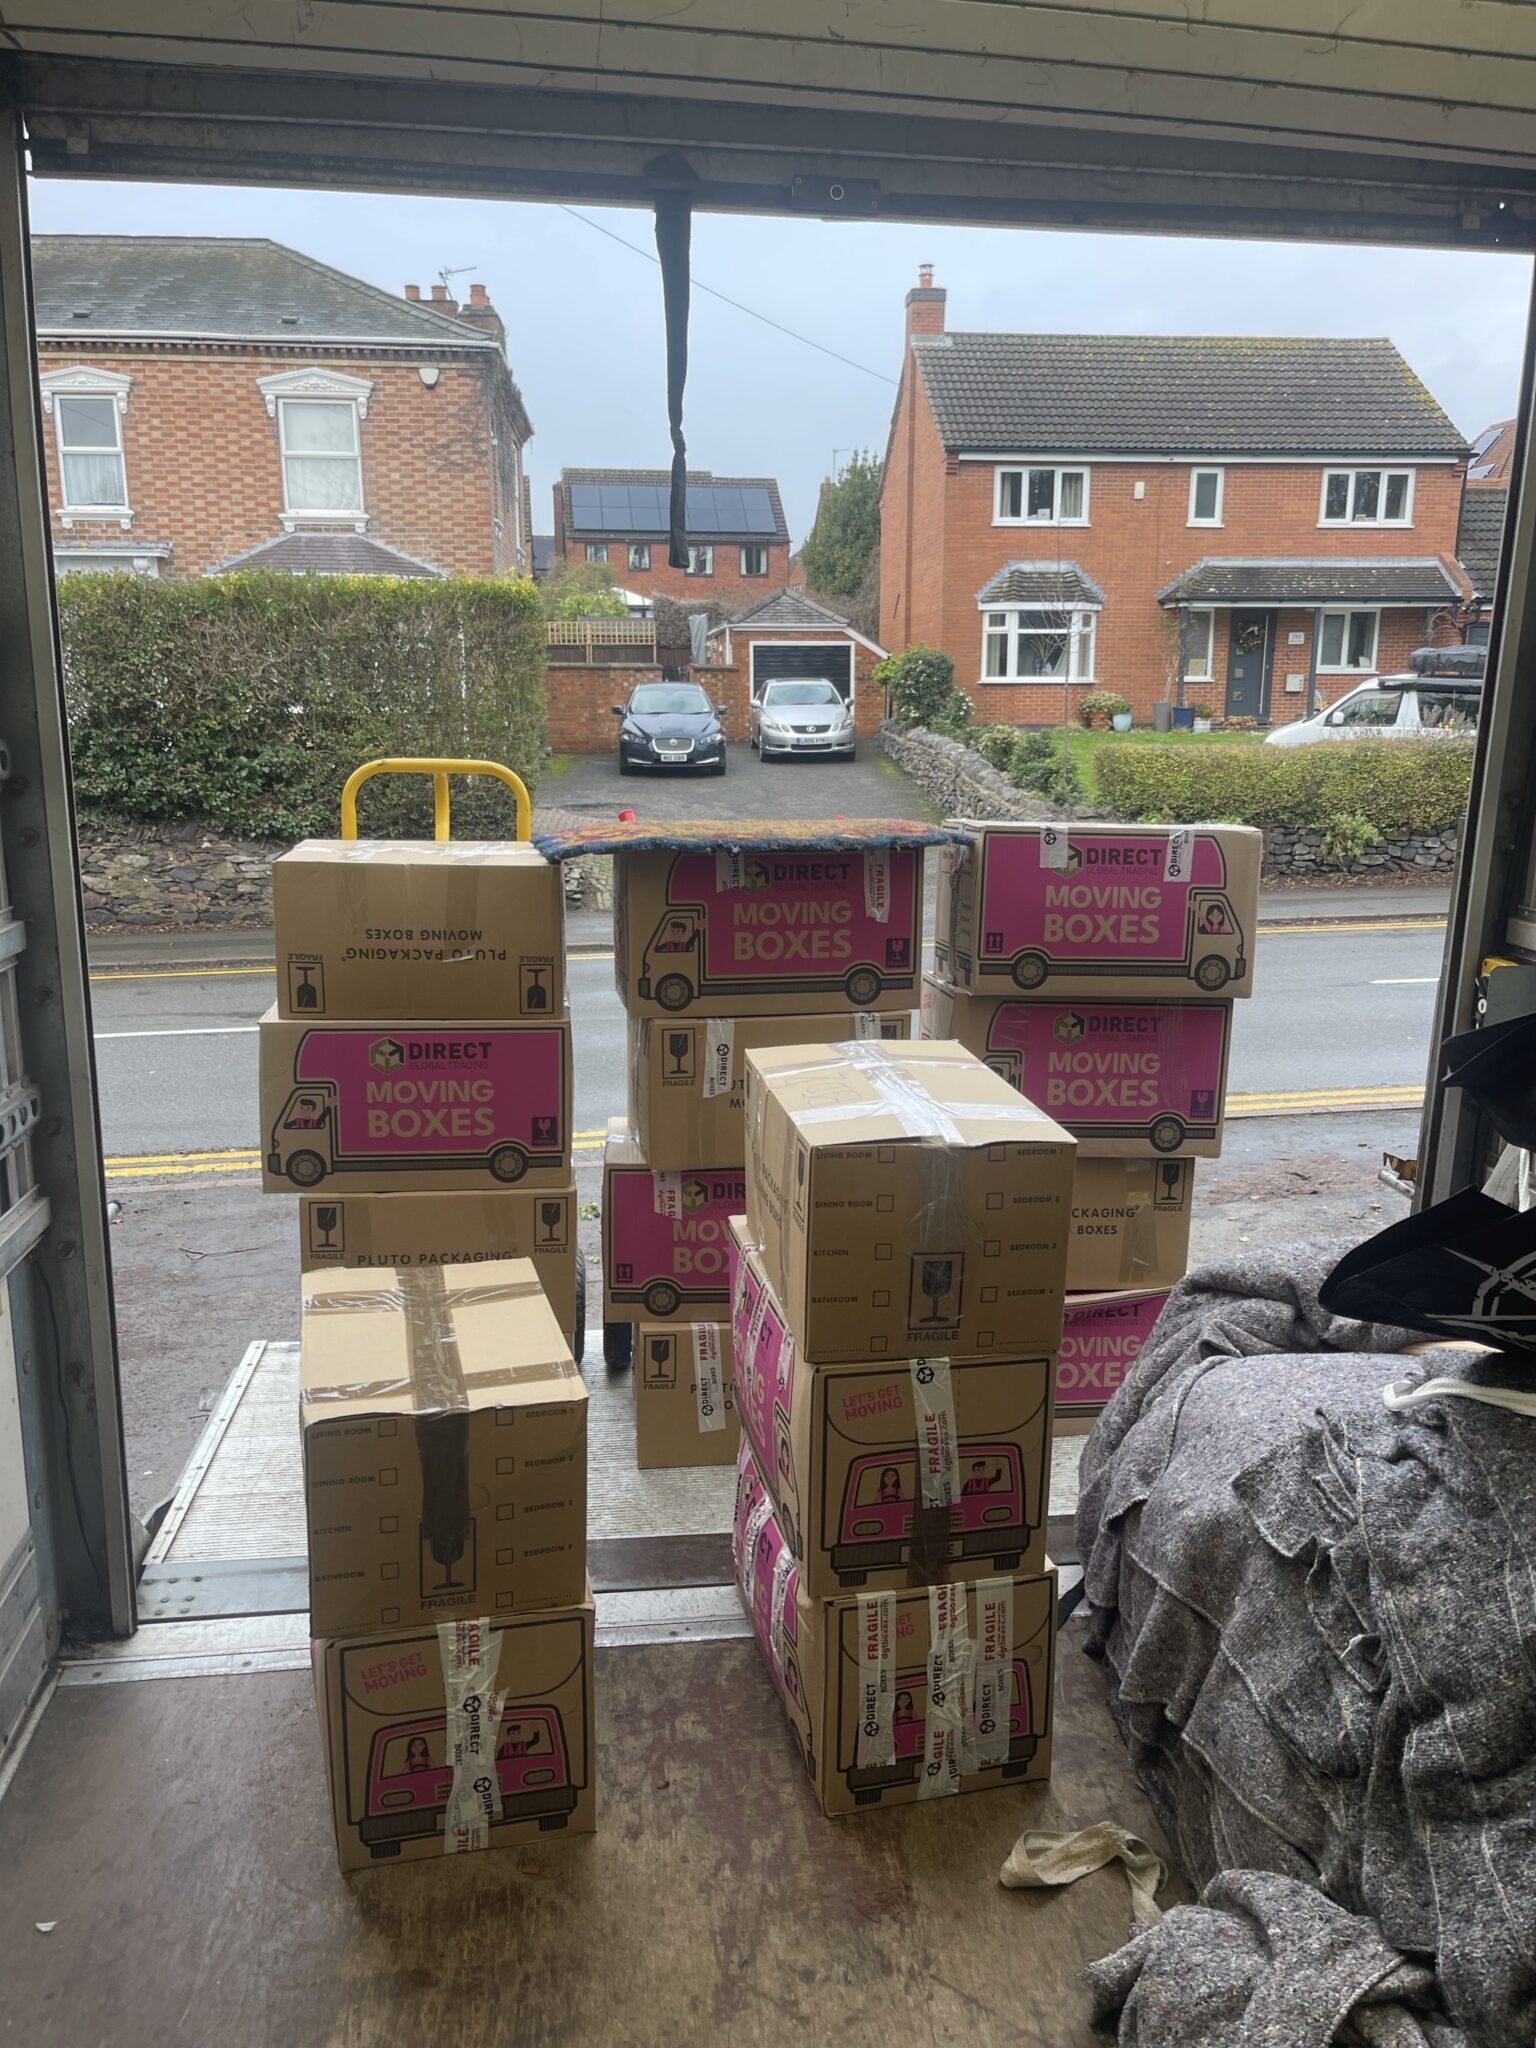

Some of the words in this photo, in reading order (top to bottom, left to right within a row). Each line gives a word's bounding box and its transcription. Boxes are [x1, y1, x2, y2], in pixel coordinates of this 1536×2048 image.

[1086, 848, 1163, 866] DIRECT
[773, 863, 850, 881] DIRECT
[1086, 867, 1119, 875] GLOBAL
[1120, 867, 1158, 876] TRADING
[773, 882, 808, 891] GLOBAL
[810, 881, 848, 890] TRADING
[876, 863, 885, 909] FRAGILE
[1045, 885, 1162, 909] MOVING
[733, 901, 852, 926] MOVING
[365, 928, 414, 940] BOXES
[420, 929, 483, 941] MOVING
[1043, 914, 1160, 943] BOXES
[734, 930, 852, 961] BOXES
[287, 953, 323, 961] FRAGILE
[452, 948, 507, 961] PLUTO
[1088, 1016, 1163, 1033] DIRECT
[409, 1042, 492, 1060] DIRECT
[409, 1061, 446, 1071] GLOBAL
[448, 1060, 488, 1070] TRADING
[1048, 1051, 1161, 1075] MOVING
[719, 1056, 729, 1087] DIRECT
[662, 1079, 697, 1087] FRAGILE
[366, 1079, 495, 1104] MOVING
[1046, 1078, 1159, 1107] BOXES
[367, 1107, 496, 1138] BOXES
[1016, 1148, 1057, 1157] BEDROOM
[667, 1190, 676, 1217] FRAG
[814, 1200, 846, 1209] DINING
[847, 1199, 873, 1208] ROOM
[1012, 1196, 1053, 1205] BEDROOM
[1153, 1205, 1184, 1213] FRAGILE
[1076, 1225, 1118, 1236] BOXES
[534, 1246, 569, 1255] FRAGILE
[813, 1248, 849, 1257] KITCHEN
[1009, 1243, 1050, 1252] BEDROOM
[310, 1252, 345, 1261] FRAGILE
[357, 1254, 411, 1267] PLUTO
[811, 1295, 858, 1304] BATHROOM
[1006, 1288, 1046, 1297] BEDROOM
[1072, 1302, 1144, 1320] DIRECT
[906, 1330, 960, 1343] FRAGILE
[643, 1382, 677, 1391] FRAGILE
[701, 1377, 709, 1405] DIRECT
[841, 1391, 877, 1409] LET'S
[877, 1384, 900, 1400] GET
[525, 1408, 568, 1419] BEDROOM
[844, 1397, 904, 1421] MOVING
[311, 1428, 341, 1440] LIVING
[925, 1413, 940, 1475] FRAGILE
[524, 1456, 566, 1469] BEDROOM
[312, 1477, 345, 1489] DINING
[348, 1475, 376, 1485] ROOM
[523, 1501, 566, 1513] BEDROOM
[313, 1524, 352, 1536] KITCHEN
[523, 1546, 565, 1558] BEDROOM
[314, 1570, 365, 1583] BATHROOM
[420, 1594, 477, 1611] FRAGILE
[867, 1600, 879, 1661] FRAGILE
[984, 1602, 996, 1662] FRAGILE
[361, 1658, 398, 1681] LET'S
[400, 1652, 423, 1670] GET
[933, 1654, 944, 1691] DIRECT
[363, 1666, 428, 1693] MOVING
[866, 1683, 876, 1721] DIRECT
[981, 1683, 992, 1719] DIRECT
[469, 1714, 481, 1756] DIRECT
